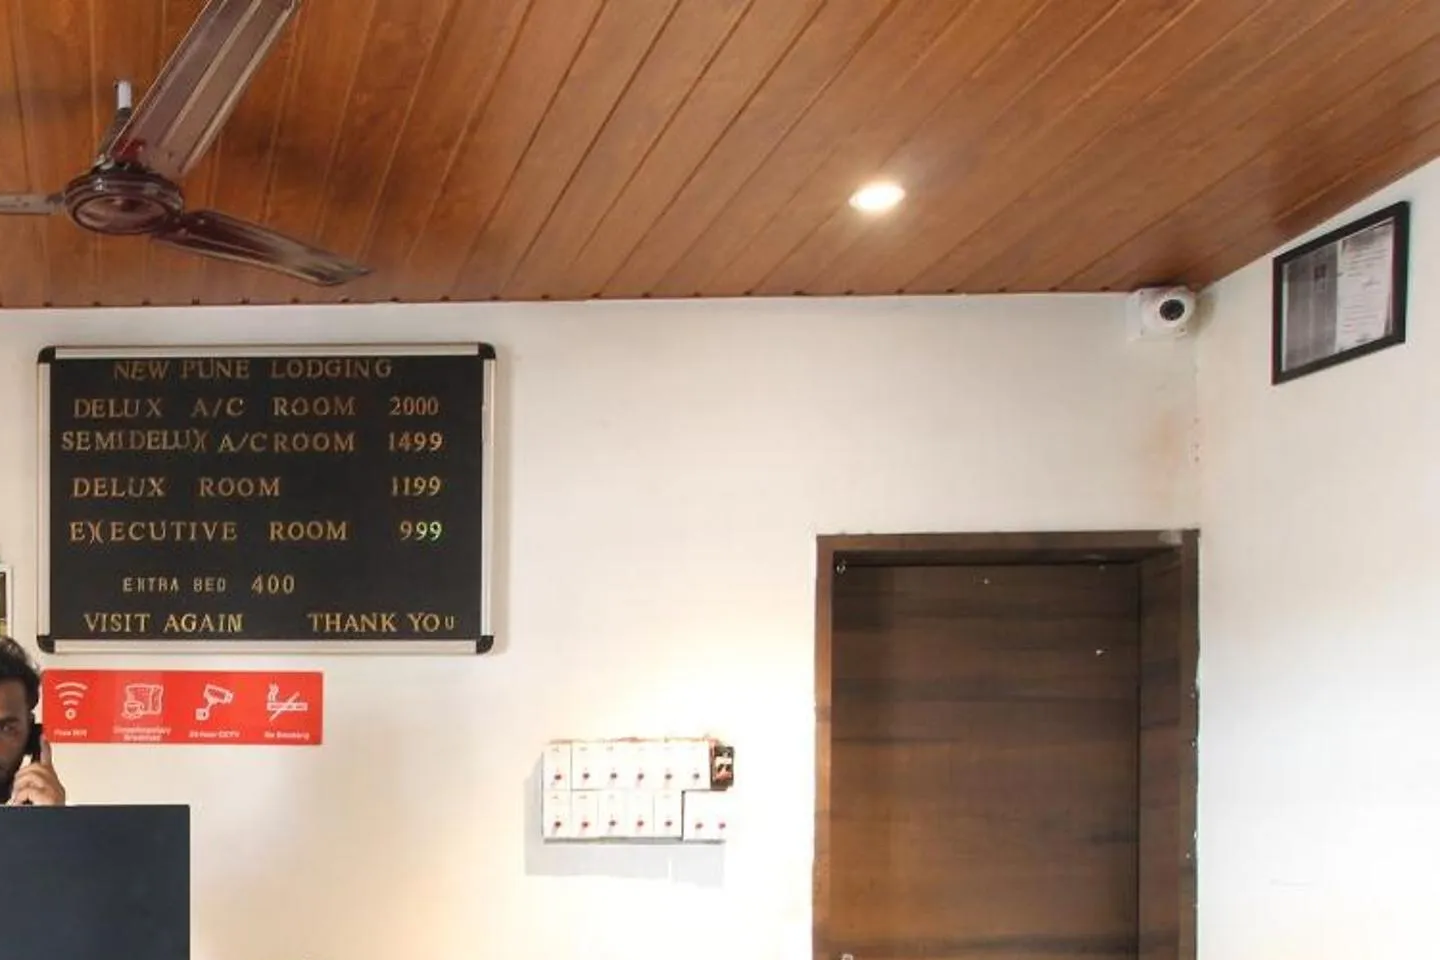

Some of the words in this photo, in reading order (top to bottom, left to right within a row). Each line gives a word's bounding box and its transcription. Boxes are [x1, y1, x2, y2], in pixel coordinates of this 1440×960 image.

[113, 360, 170, 379] NEW
[181, 358, 250, 379] PUNE
[270, 358, 393, 379] LODGING
[73, 398, 163, 418] DELUX
[190, 398, 245, 418] A/C
[273, 396, 356, 416] ROOM
[389, 396, 440, 416] 2000
[273, 432, 355, 453] ROOM
[388, 430, 444, 452] 1499
[72, 476, 166, 498] DELUX
[198, 476, 281, 498] ROOM
[391, 476, 442, 497] 1199
[69, 521, 239, 543] EXECUTIVE
[268, 520, 349, 541] ROOM
[399, 520, 443, 541] 999
[122, 576, 180, 593] EXTRA
[193, 576, 227, 593] BED
[251, 574, 295, 595] 400
[83, 612, 151, 633] VISIT
[163, 612, 244, 633] AGAIN
[306, 611, 398, 634] THANK
[407, 611, 456, 633] YOU
